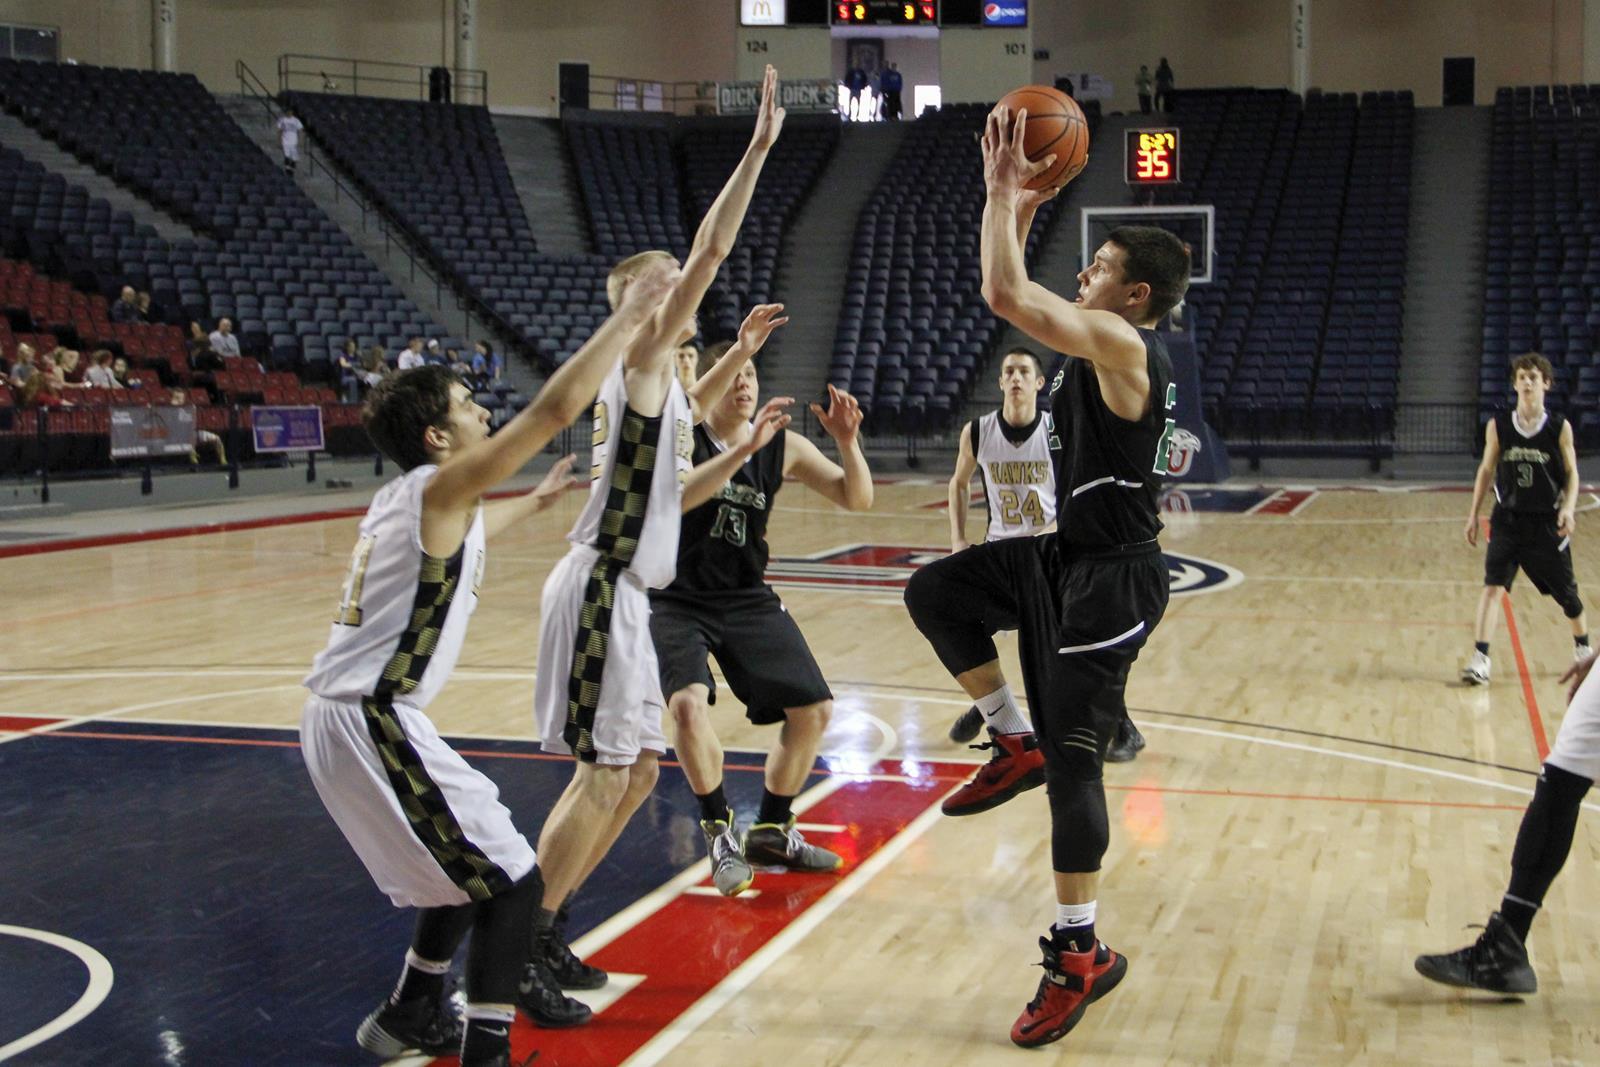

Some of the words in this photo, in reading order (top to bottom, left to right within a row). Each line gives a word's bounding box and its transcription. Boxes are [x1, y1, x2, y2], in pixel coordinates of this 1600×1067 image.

[746, 40, 768, 53] 124
[1004, 43, 1026, 55] 101
[1137, 150, 1169, 177] 35
[987, 460, 1050, 486] HAWKS
[1517, 463, 1534, 488] 3
[999, 489, 1046, 527] 24
[709, 503, 747, 547] 13
